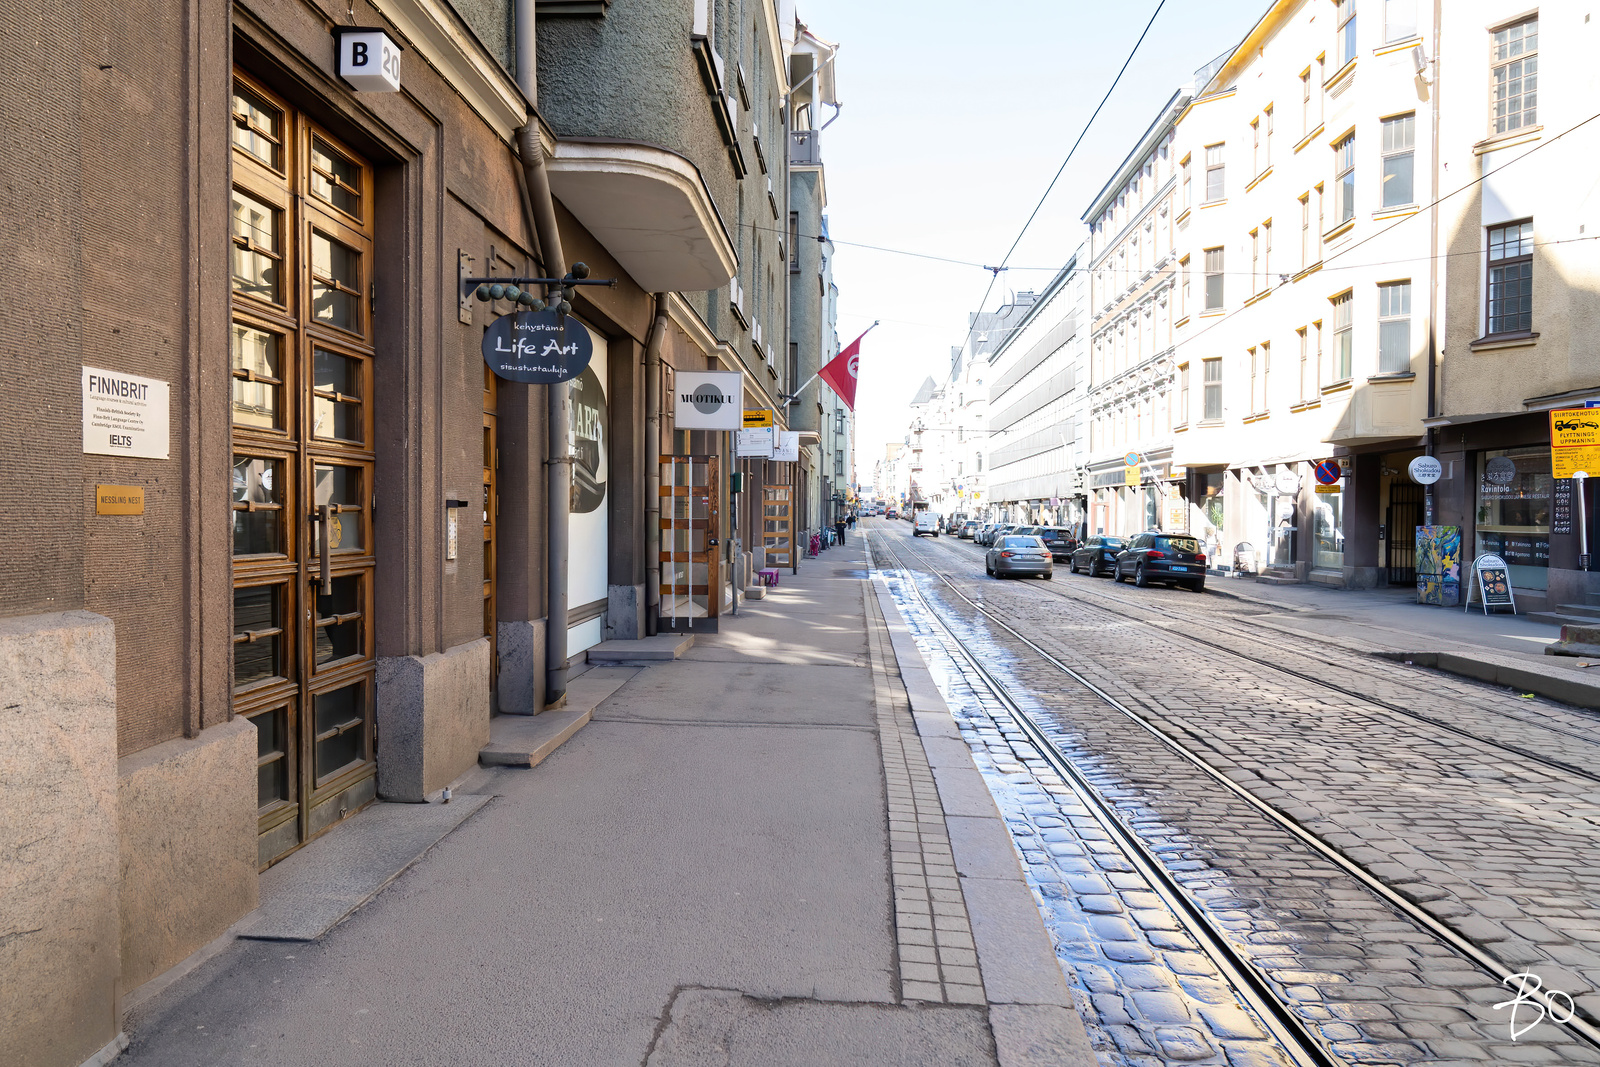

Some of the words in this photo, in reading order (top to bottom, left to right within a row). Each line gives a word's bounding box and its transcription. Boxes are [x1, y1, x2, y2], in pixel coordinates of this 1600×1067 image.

[352, 42, 369, 67] B
[383, 46, 400, 81] 20
[513, 321, 565, 333] kehystämö
[494, 335, 537, 359] Life
[540, 338, 579, 357] Art
[500, 362, 568, 378] sisustustauluja
[89, 374, 149, 401] FINNBRIT
[680, 394, 735, 404] MUOTIKUU
[1553, 410, 1600, 418] SIIRTOKEHOTUS
[109, 434, 132, 446] IELTS
[1560, 437, 1596, 445] UPPMANING
[1480, 484, 1510, 493] Ravintola
[100, 495, 126, 504] NESSLING
[127, 496, 141, 504] NEST
